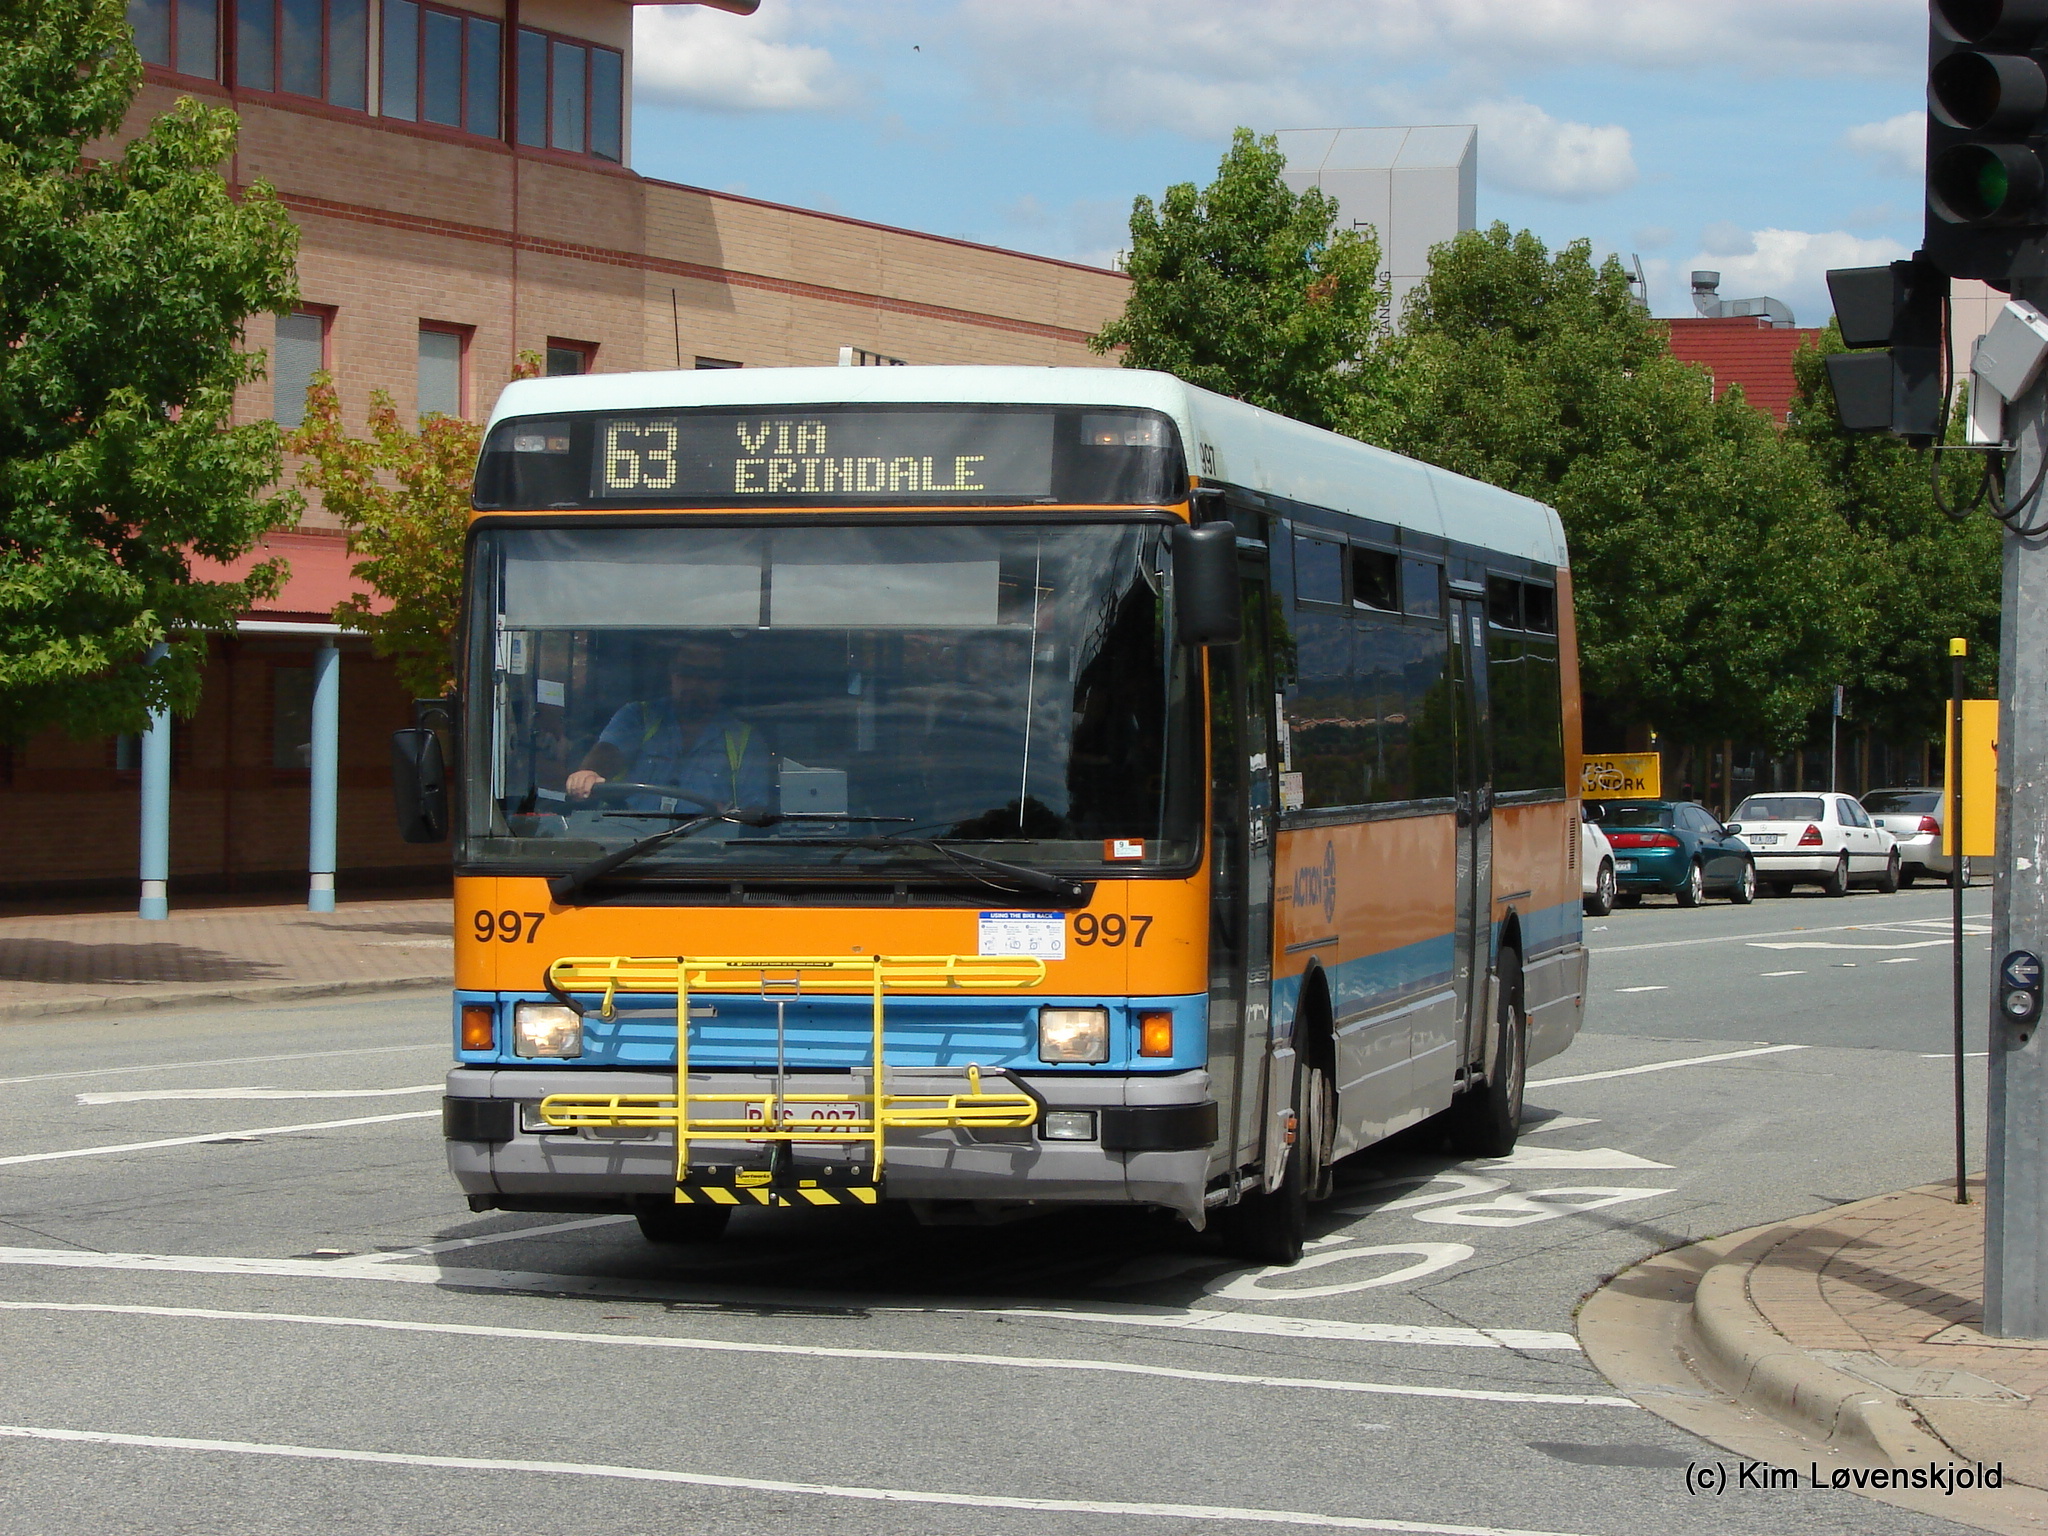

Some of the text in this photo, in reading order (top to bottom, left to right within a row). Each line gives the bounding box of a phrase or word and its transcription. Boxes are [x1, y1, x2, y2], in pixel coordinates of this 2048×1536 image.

[605, 420, 678, 489] 63
[736, 421, 827, 455] VIA
[735, 456, 985, 493] ERINDALE
[1199, 442, 1216, 476] 997
[1293, 866, 1322, 908] ACTION
[474, 910, 545, 943] 997
[1073, 912, 1153, 947] 997
